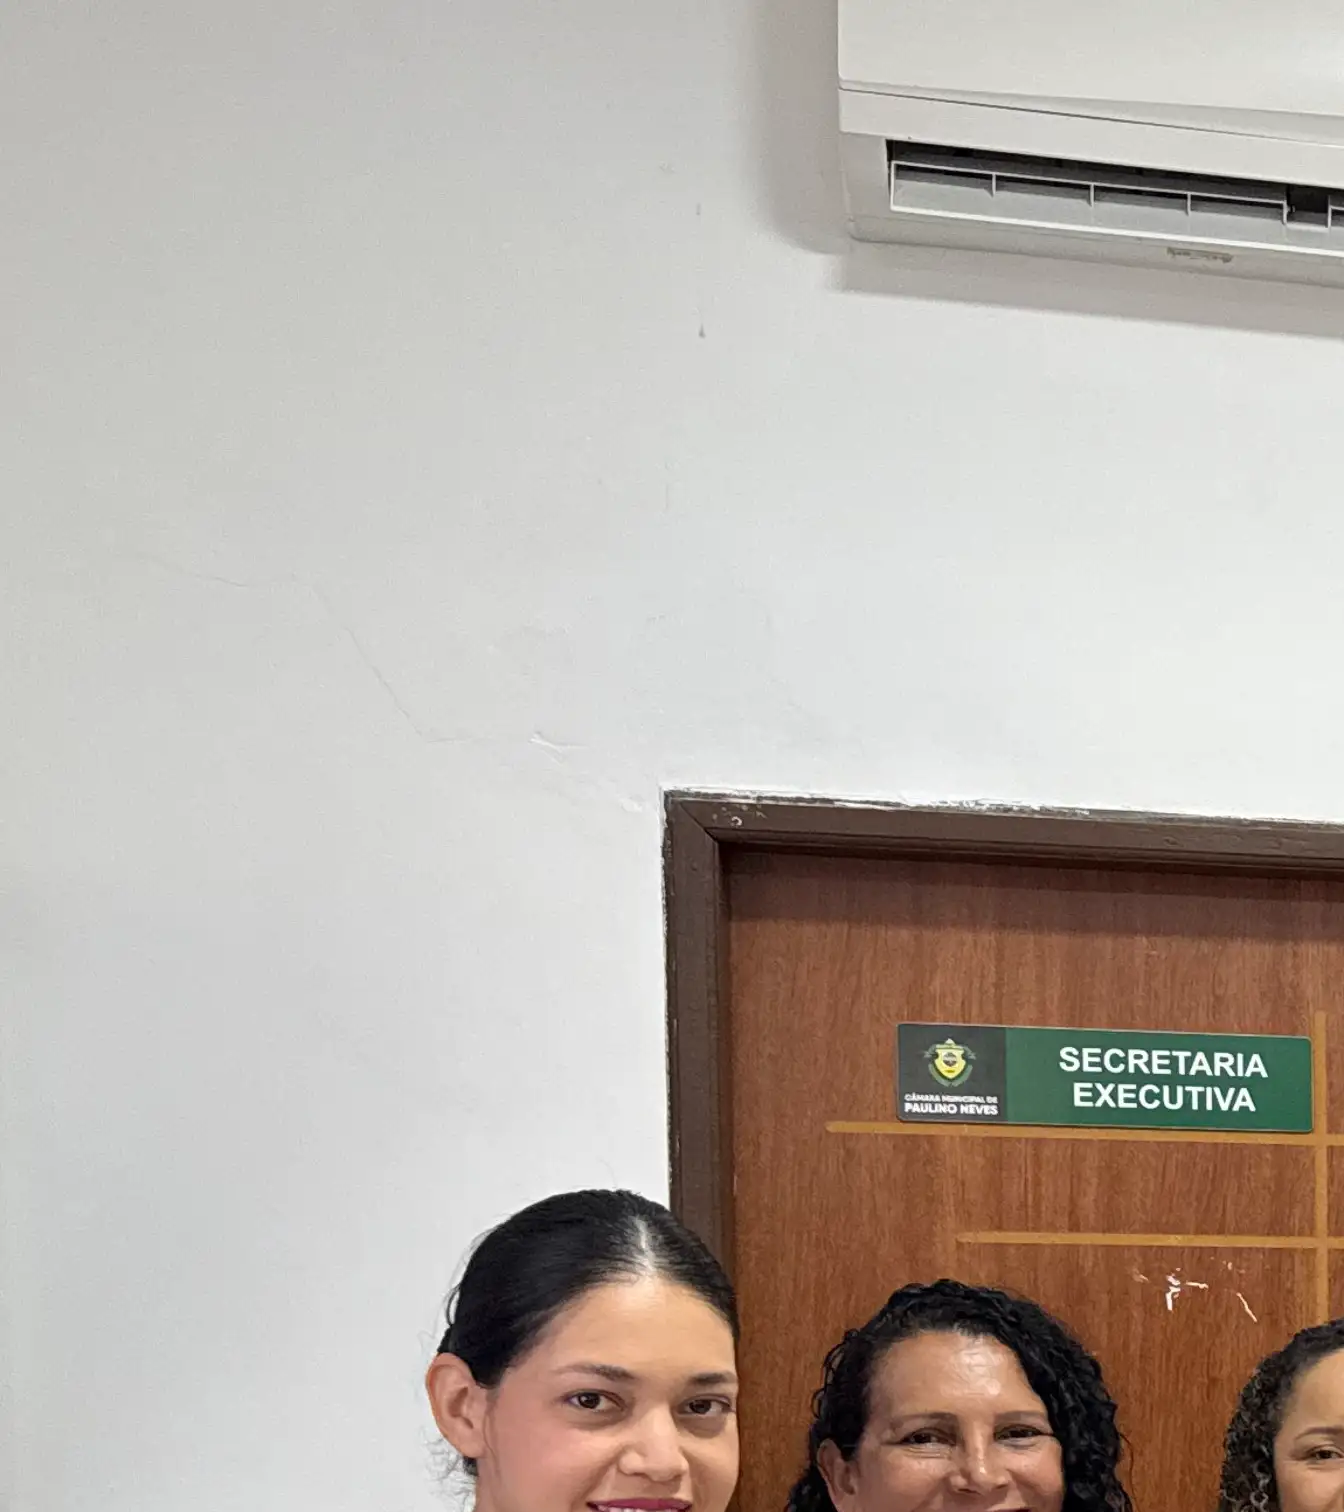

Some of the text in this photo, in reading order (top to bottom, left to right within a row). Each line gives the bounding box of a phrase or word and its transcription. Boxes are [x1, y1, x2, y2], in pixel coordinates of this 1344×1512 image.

[1059, 1046, 1268, 1078] SECRETARIA
[904, 1102, 998, 1115] PAULINO NEVES
[1073, 1082, 1256, 1112] EXECUTIVA
